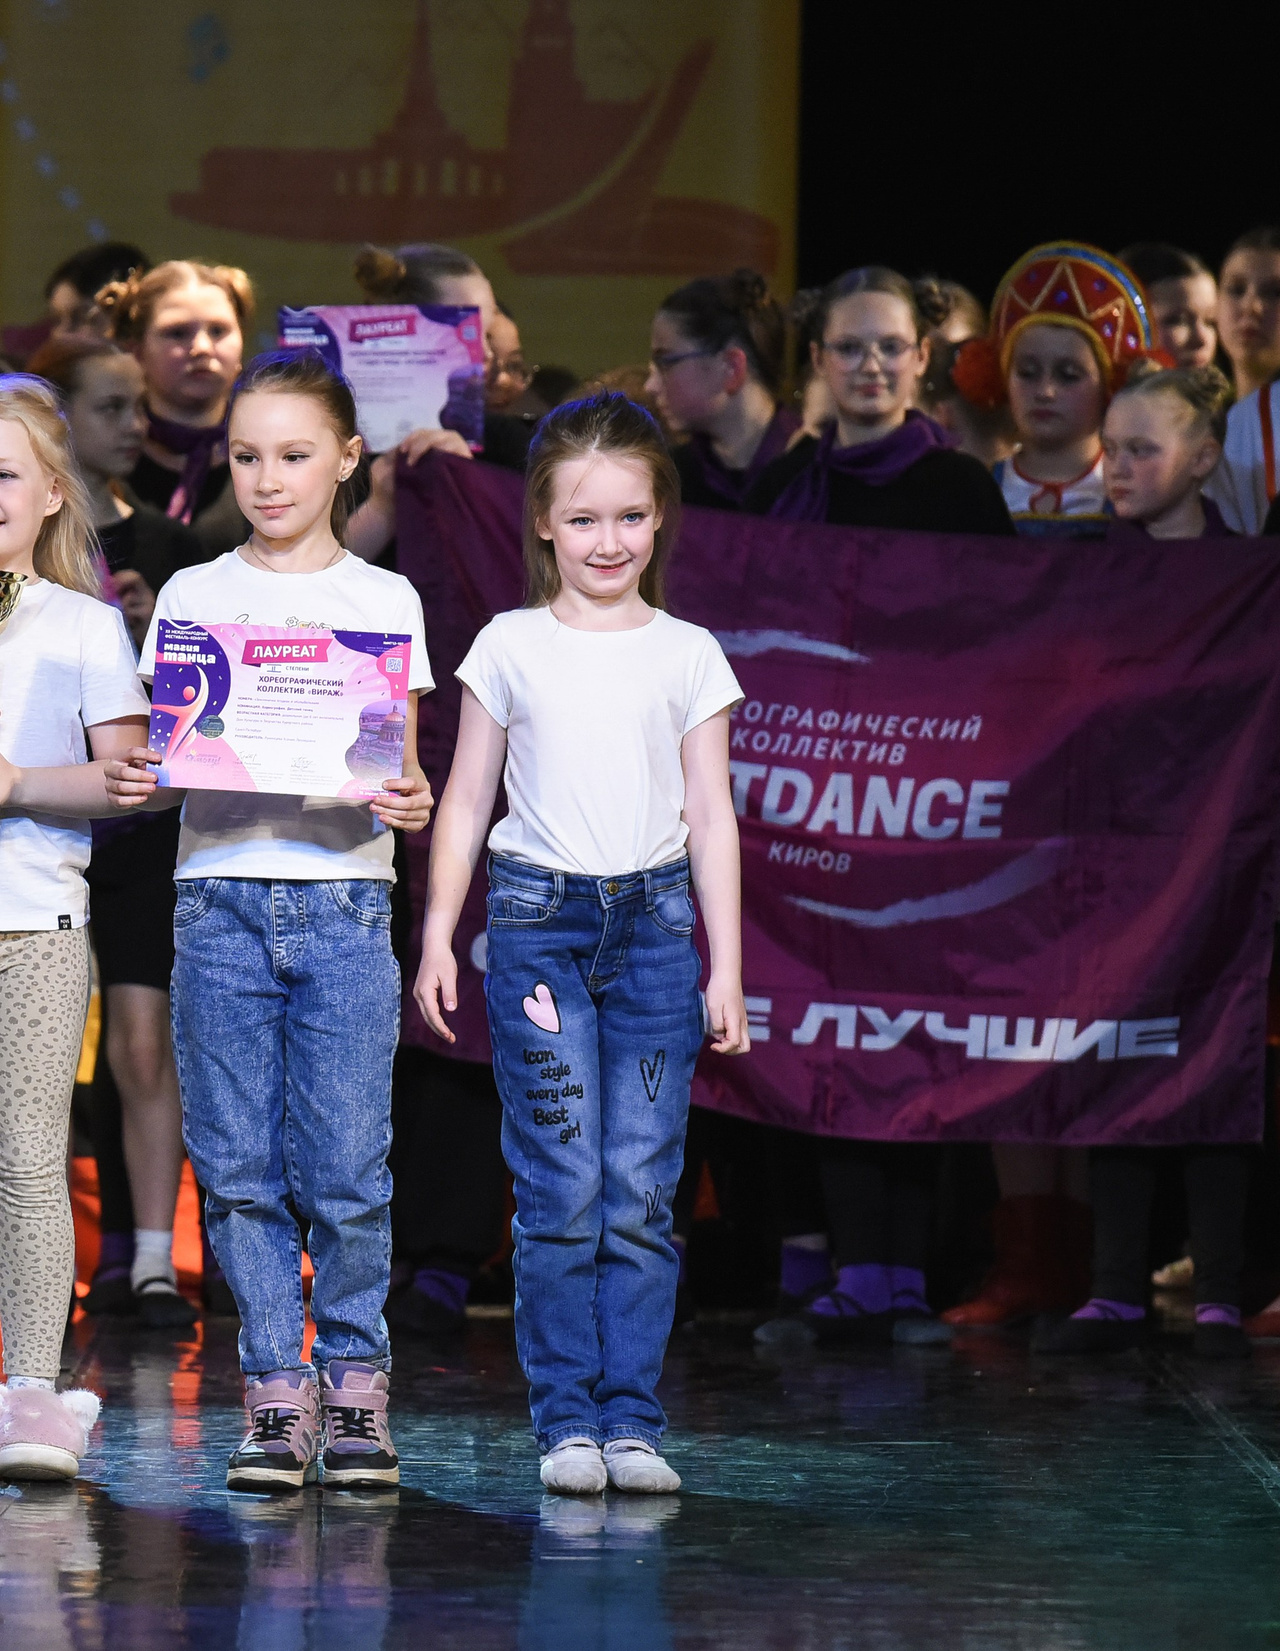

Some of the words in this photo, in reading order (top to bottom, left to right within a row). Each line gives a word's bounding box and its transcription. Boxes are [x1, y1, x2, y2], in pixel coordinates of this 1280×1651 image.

[164, 643, 200, 652] магия
[252, 645, 318, 658] ЛАУРЕАТ
[163, 652, 216, 665] танца
[258, 676, 344, 687] ХОРЕОГРАФИЧЕСКИЙ
[256, 685, 305, 695] КОЛЛЕКТИВ
[307, 689, 344, 697] «ВИРАЖ»
[732, 727, 907, 765] КОЛЛЕКТИВ
[768, 840, 852, 874] КИРОВ
[792, 1002, 1180, 1062] ЛУЧШИЕ
[524, 1048, 556, 1065] Icon
[540, 1062, 571, 1081] style
[527, 1086, 559, 1101] every
[562, 1082, 583, 1100] day
[534, 1107, 568, 1125] Best
[559, 1121, 581, 1144] girl
